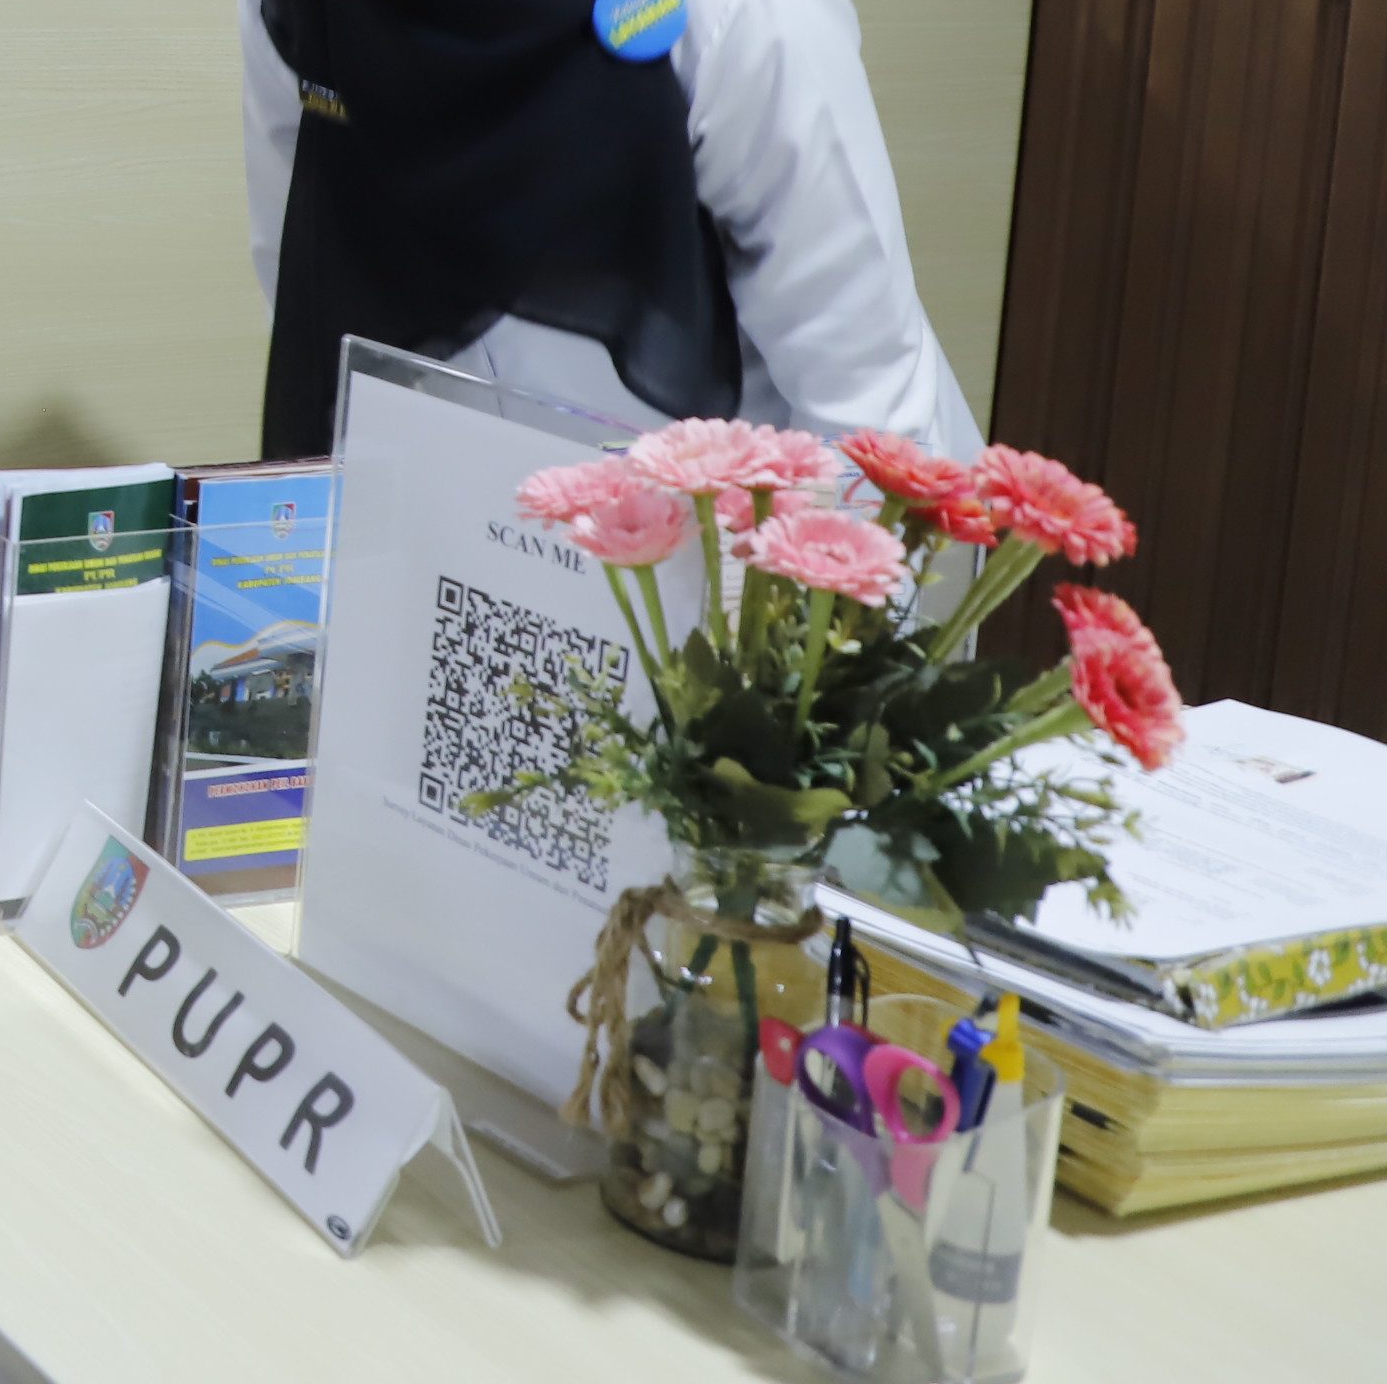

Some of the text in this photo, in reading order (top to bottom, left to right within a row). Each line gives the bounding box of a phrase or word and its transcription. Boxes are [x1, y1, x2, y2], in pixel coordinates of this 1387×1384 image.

[486, 520, 586, 575] SCAN ME
[117, 924, 355, 1175] PUPR
